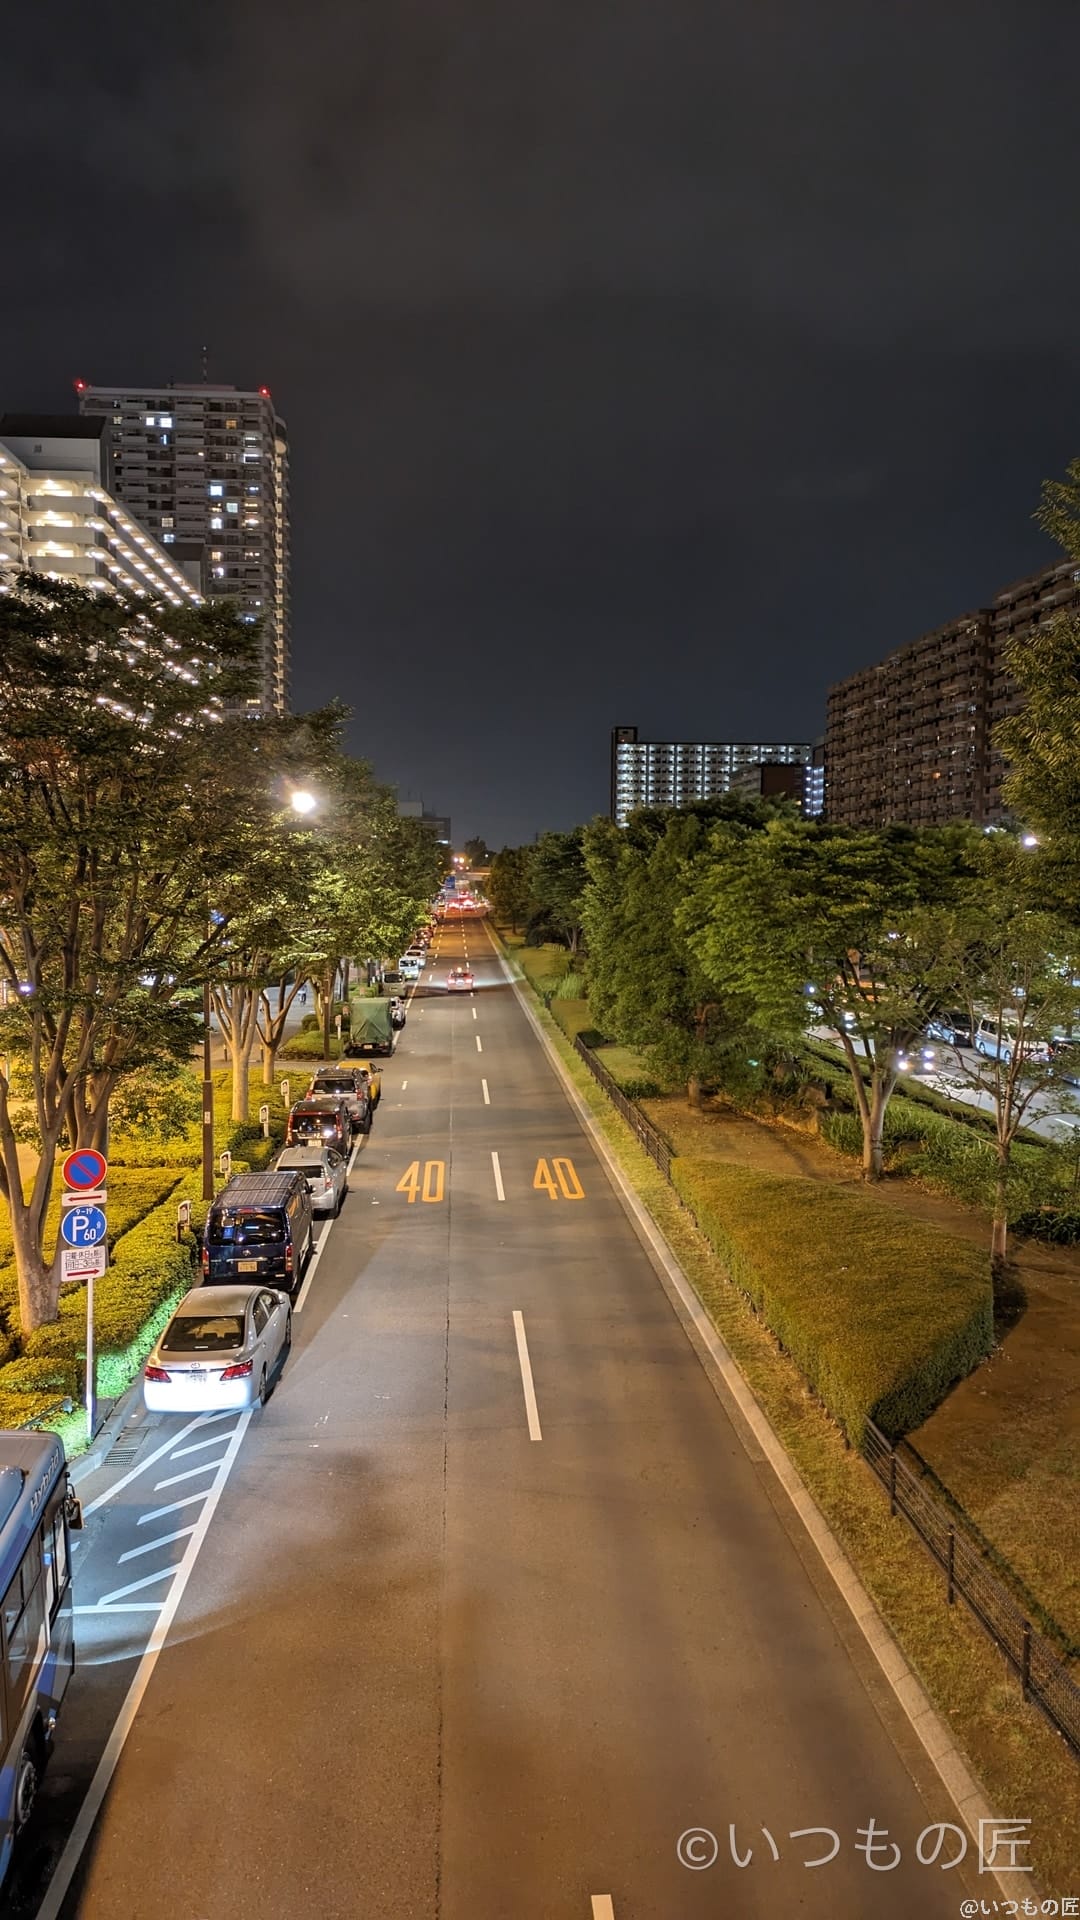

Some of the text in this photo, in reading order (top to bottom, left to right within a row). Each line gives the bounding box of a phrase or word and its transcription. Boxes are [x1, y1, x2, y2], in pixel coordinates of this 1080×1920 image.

[395, 1160, 446, 1203] 40
[532, 1157, 586, 1200] 40
[72, 1215, 89, 1242] P
[84, 1228, 96, 1240] 60
[30, 1446, 60, 1517] Hybrid
